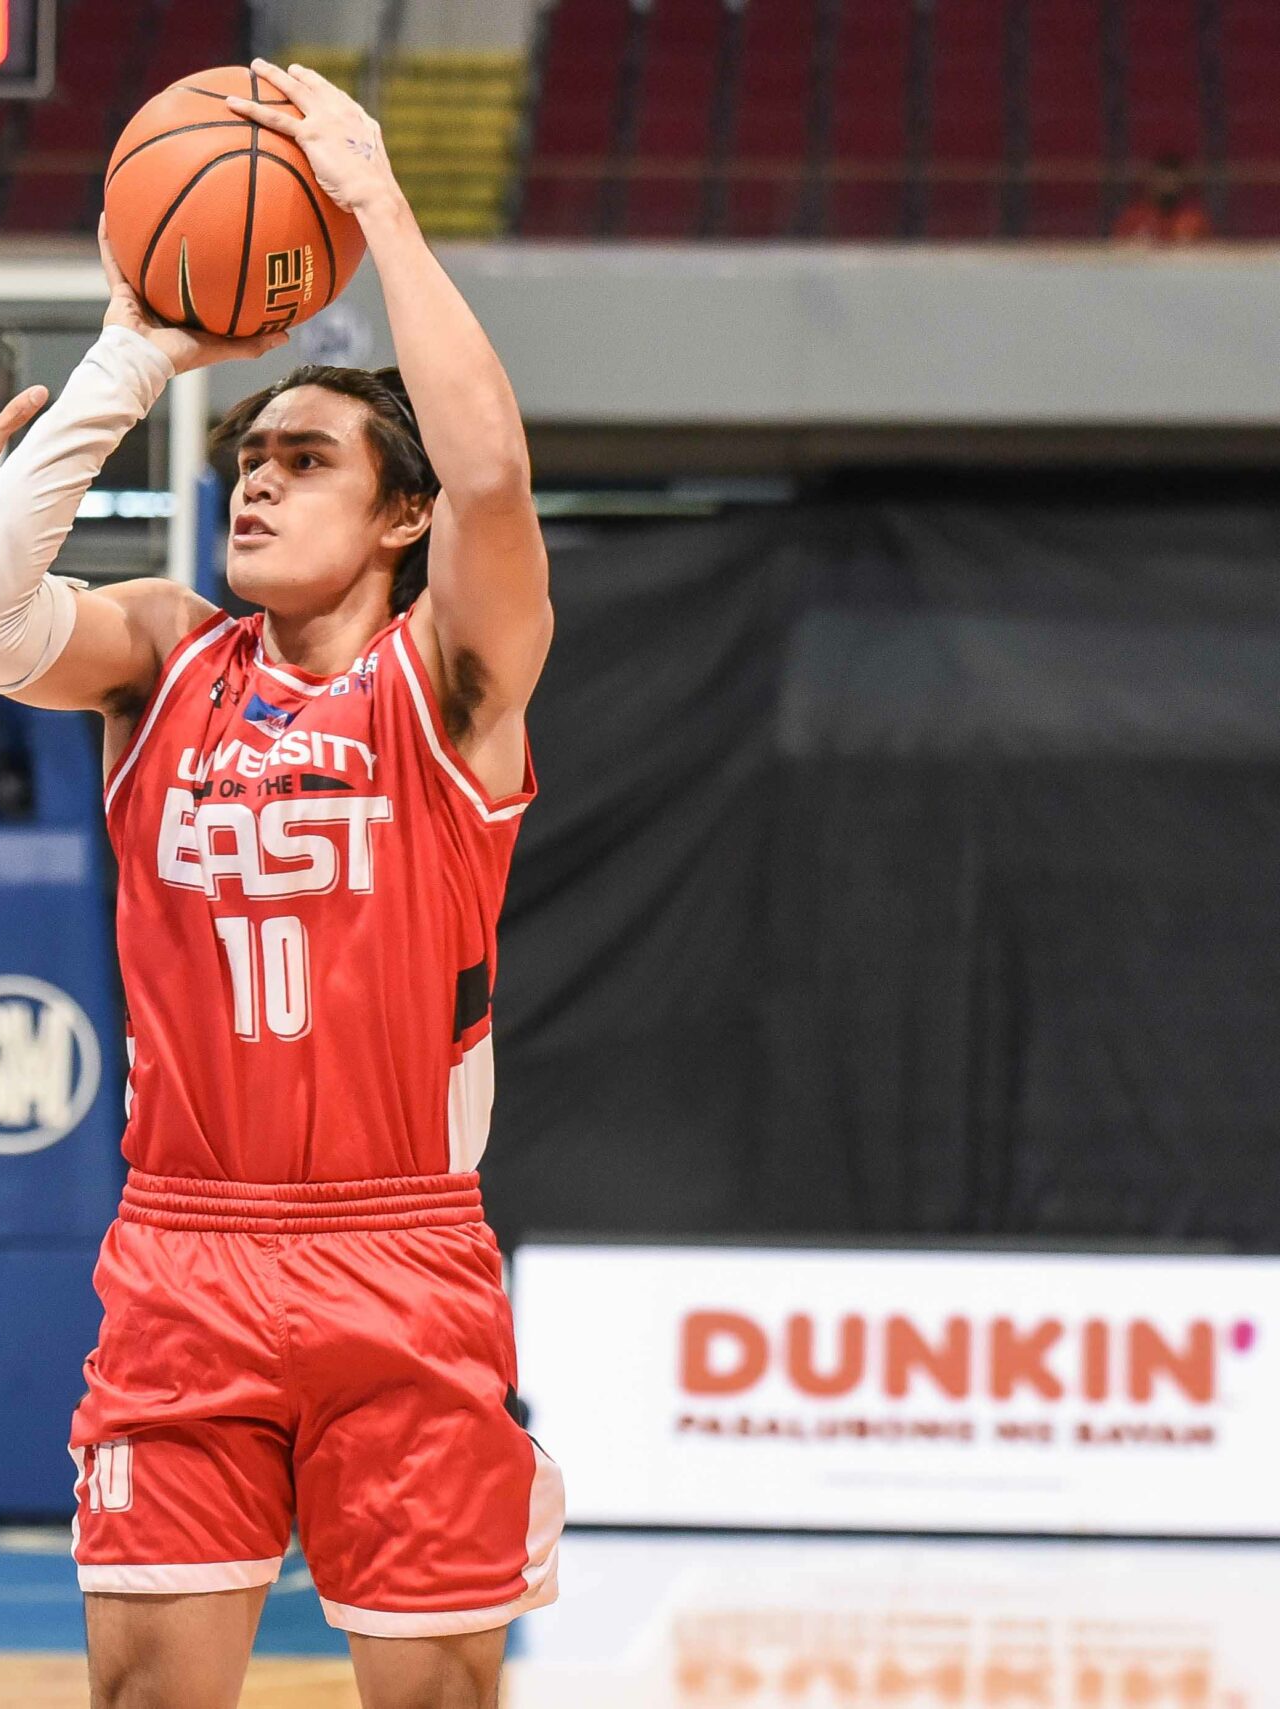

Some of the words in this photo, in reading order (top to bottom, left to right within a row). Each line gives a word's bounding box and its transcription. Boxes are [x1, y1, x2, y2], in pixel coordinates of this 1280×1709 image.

[219, 778, 247, 798] OF
[157, 787, 394, 901] EAST
[215, 914, 313, 1044] 10
[680, 1310, 1255, 1404] DUNKIN'
